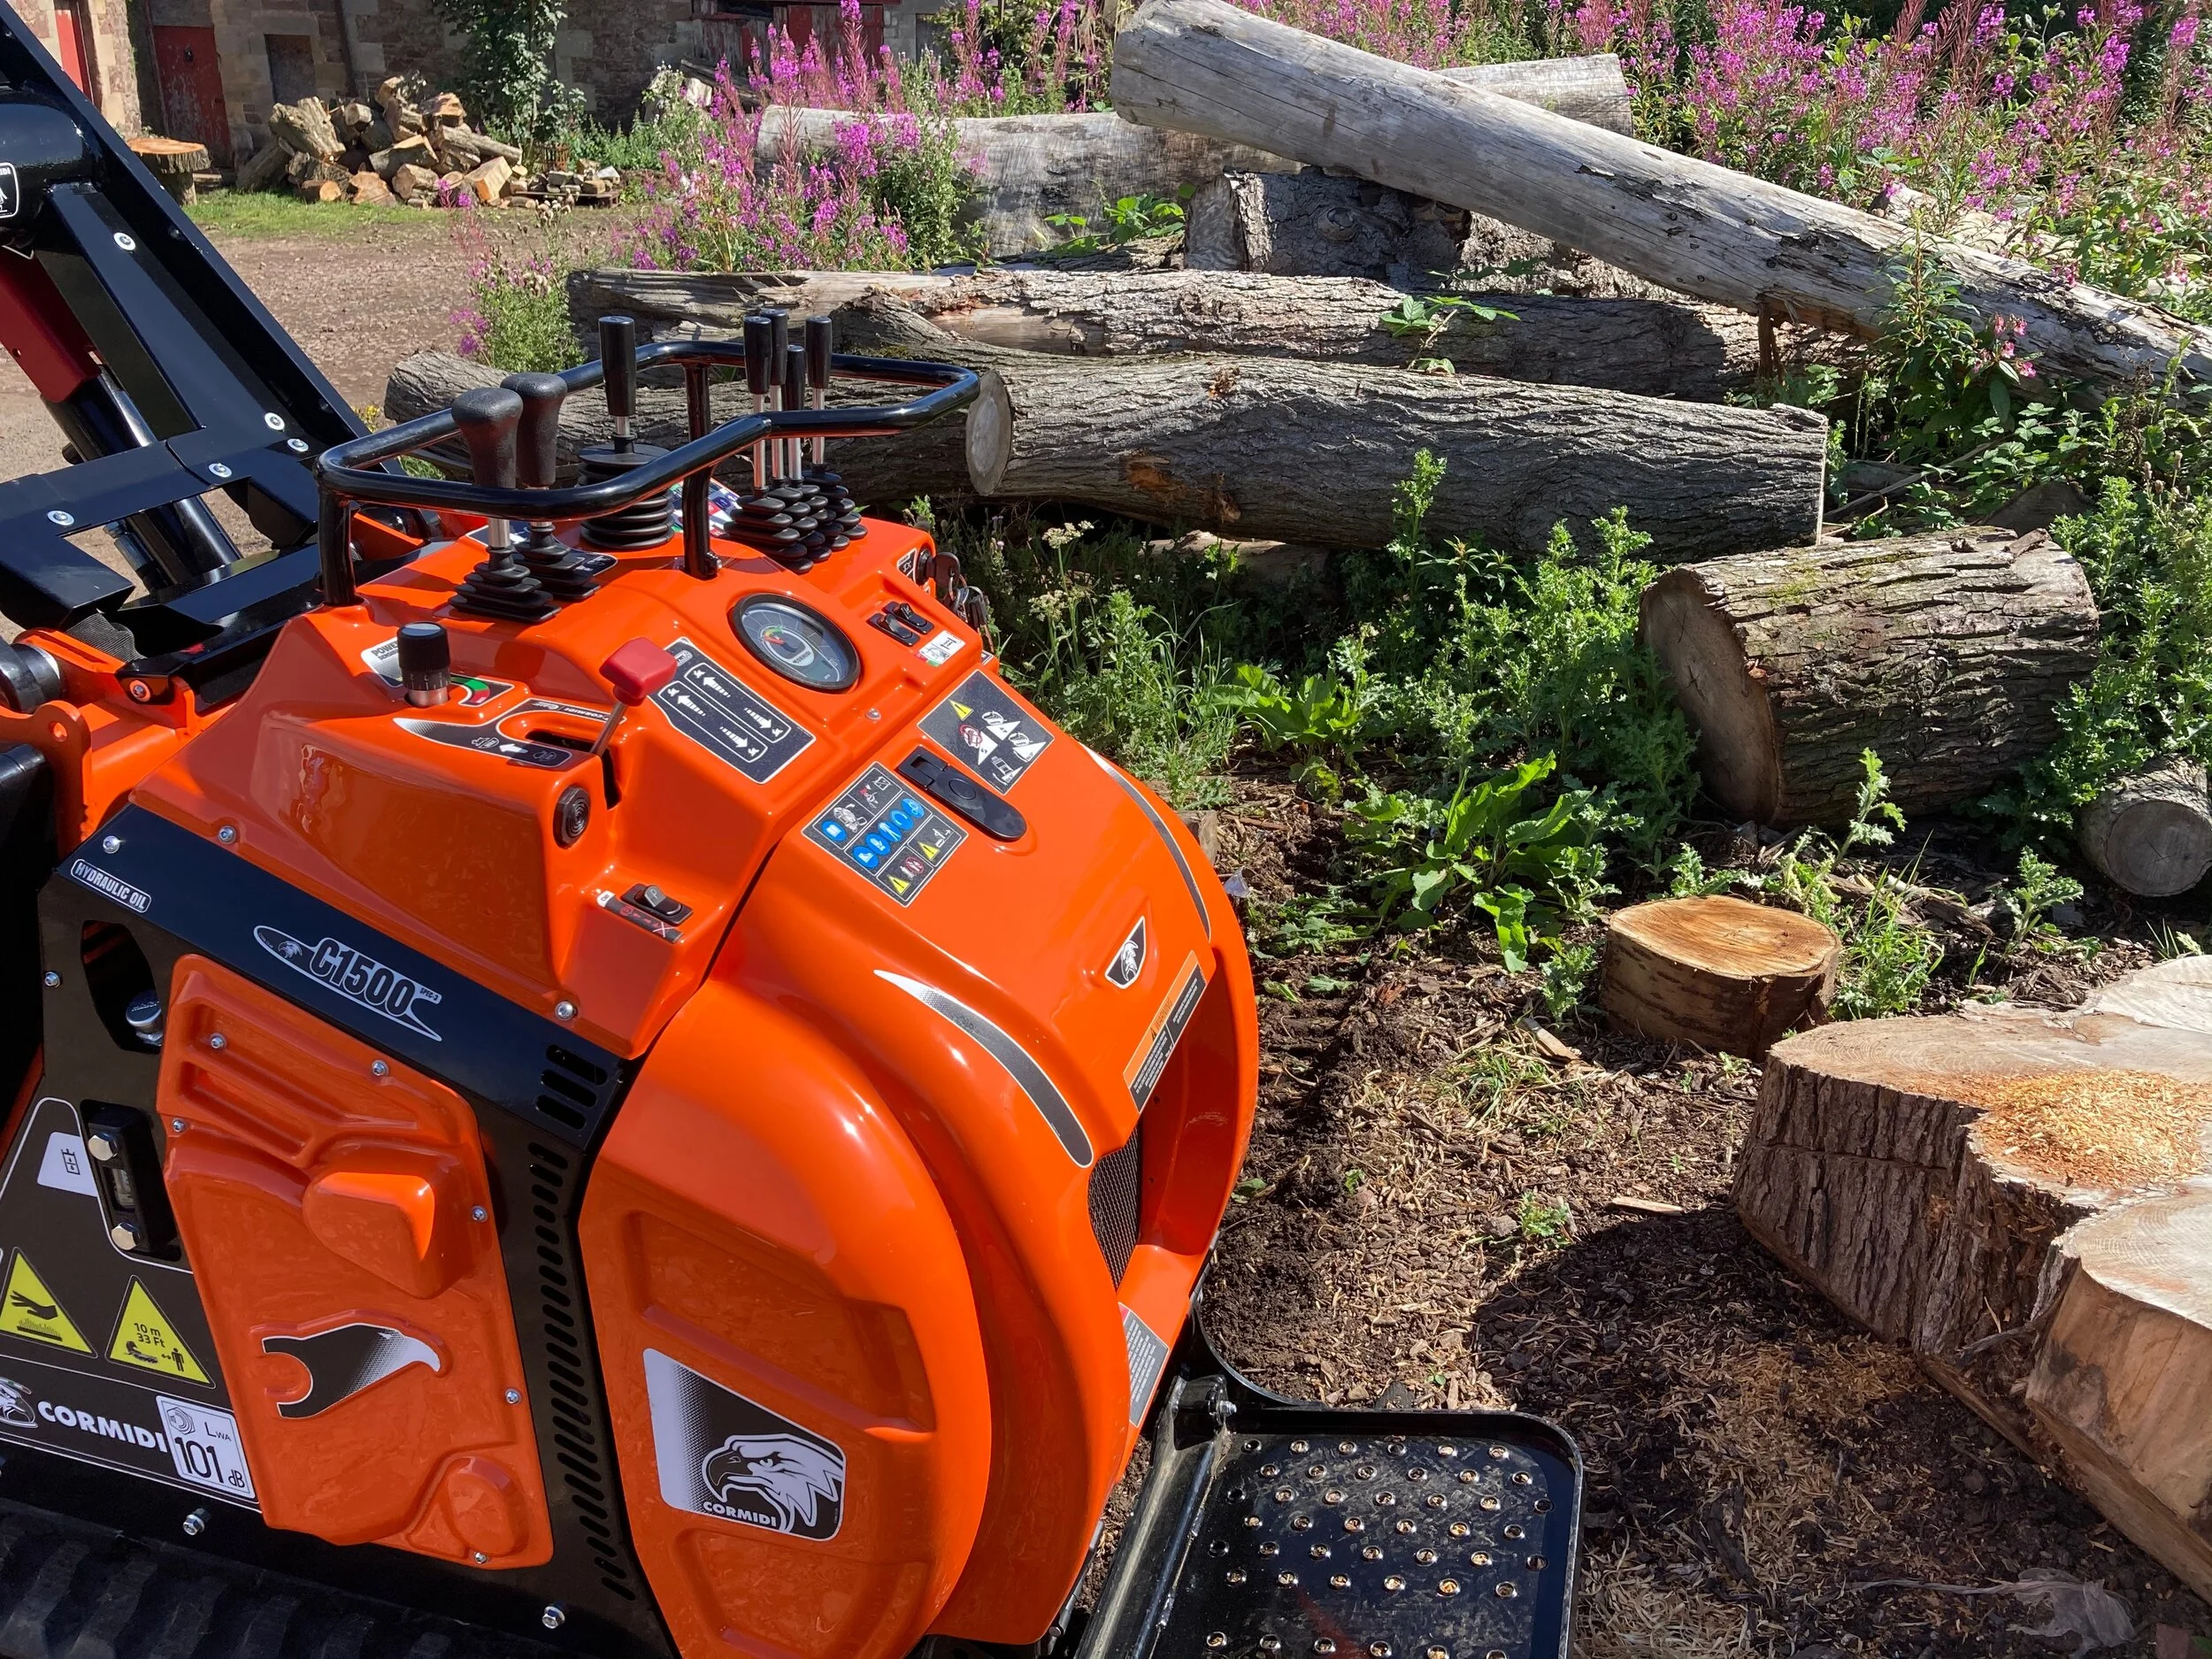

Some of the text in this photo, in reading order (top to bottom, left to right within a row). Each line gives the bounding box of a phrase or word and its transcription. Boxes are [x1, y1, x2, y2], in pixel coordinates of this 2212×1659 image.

[371, 641, 398, 657] POWE
[74, 862, 147, 910] HYDRAULIC OIL
[311, 938, 416, 1017] C1500
[419, 987, 439, 1002] SPEC-3
[1154, 997, 1174, 1028] WARNING
[134, 1323, 161, 1337] 10 m
[137, 1333, 165, 1348] 33 Ft
[37, 1401, 168, 1453] CORMIDI
[174, 1436, 224, 1484] 101
[227, 1469, 245, 1488] dB
[703, 1501, 777, 1527] CORMIDI
